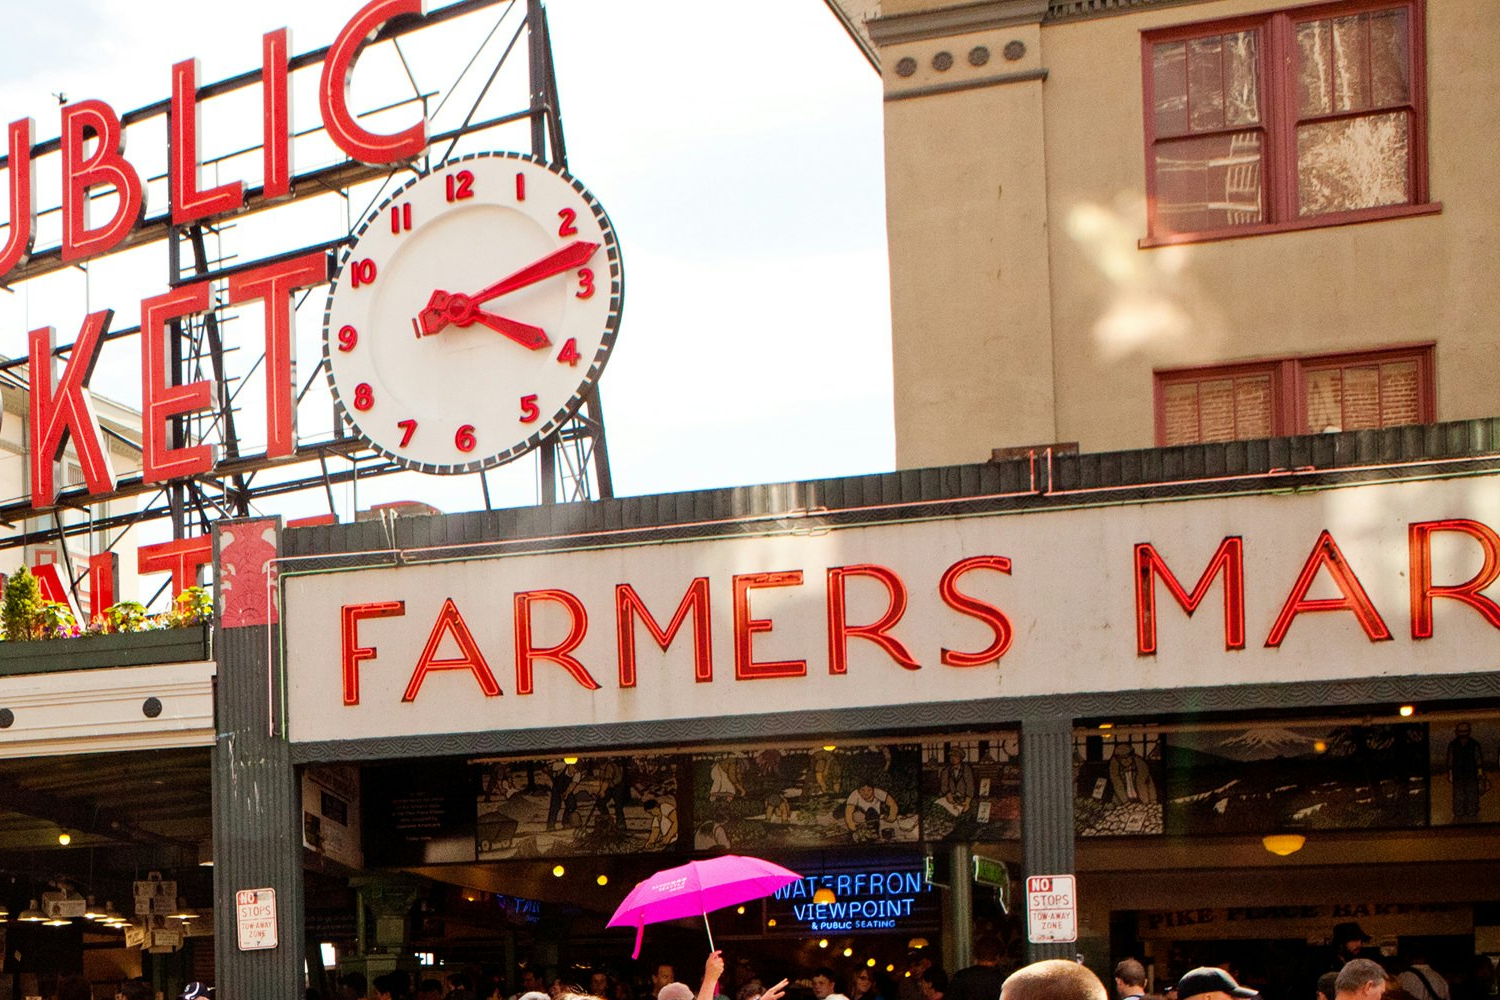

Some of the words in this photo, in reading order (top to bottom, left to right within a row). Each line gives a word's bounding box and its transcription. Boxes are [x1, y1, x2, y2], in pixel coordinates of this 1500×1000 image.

[445, 169, 475, 203] 12
[515, 172, 526, 201] 1
[390, 202, 413, 235] 11
[557, 207, 579, 238] 2
[350, 257, 378, 289] 10
[575, 267, 595, 300] 3
[337, 324, 359, 353] 9
[556, 337, 582, 367] 4
[353, 382, 375, 412] 8
[518, 394, 541, 424] 5
[397, 418, 419, 448] 7
[454, 424, 477, 452] 6
[341, 555, 1014, 707] FARMERS
[240, 892, 255, 904] NO
[1031, 878, 1050, 892] NO
[241, 905, 271, 918] STOPS
[793, 898, 915, 921] VIEWPOINT
[1033, 894, 1069, 907] STOPS
[811, 921, 819, 930] &
[820, 920, 853, 930] PUBLIC
[855, 919, 896, 929] SEATING
[1042, 921, 1063, 930] ZONE
[1150, 907, 1214, 929] PIKE
[249, 930, 266, 938] ZONE
